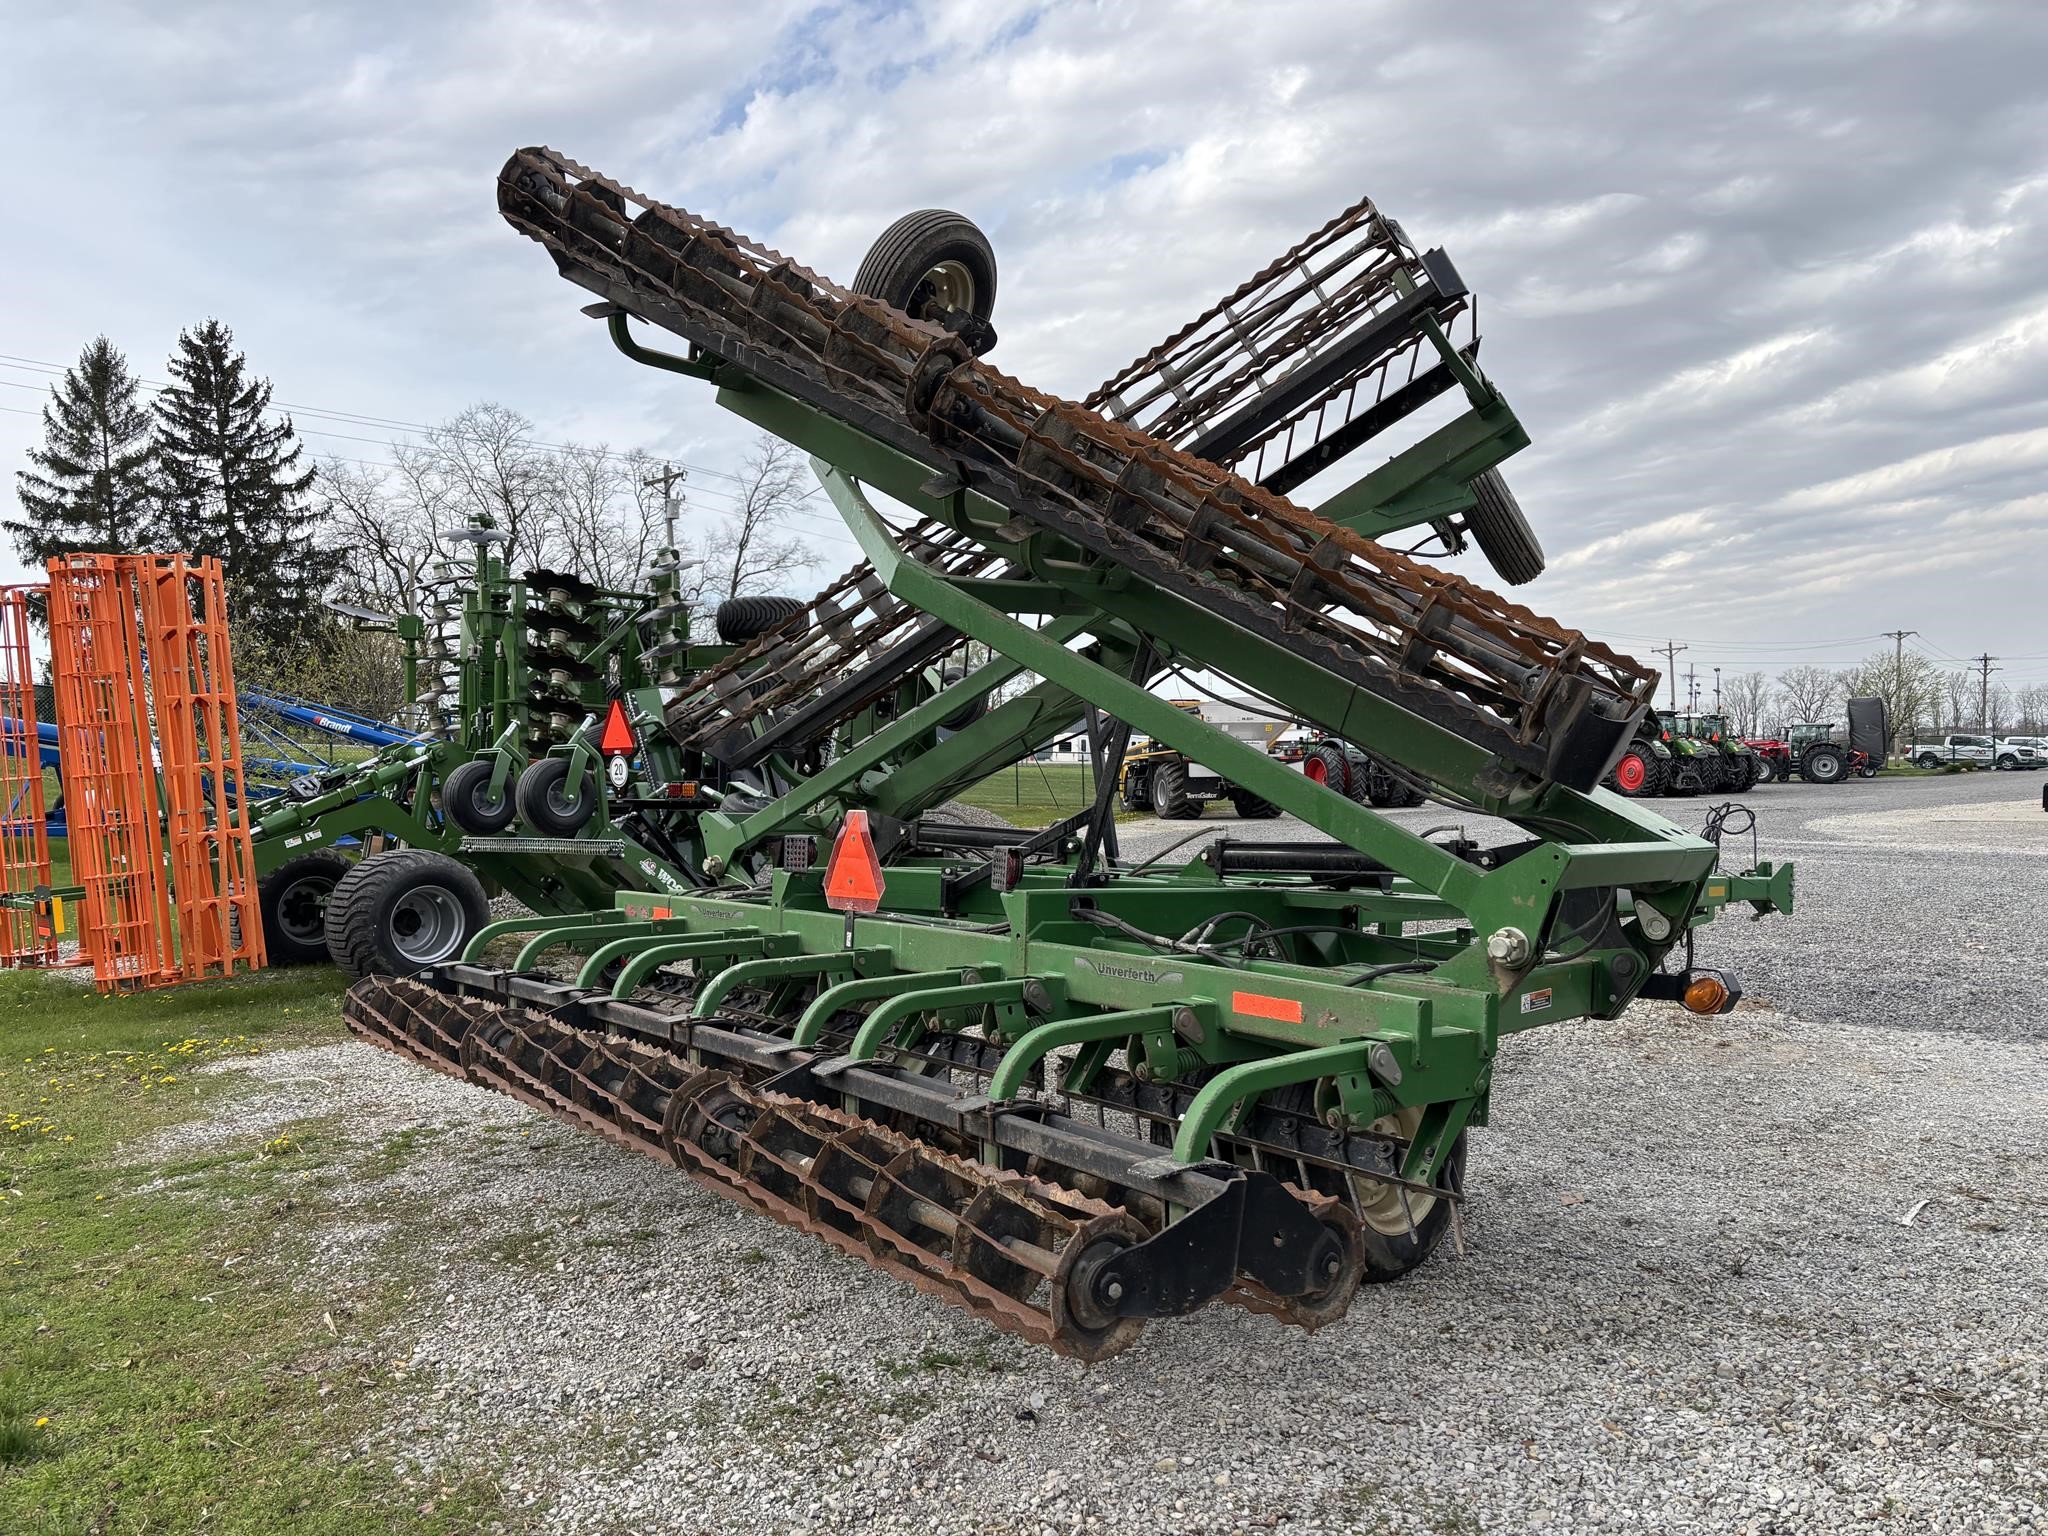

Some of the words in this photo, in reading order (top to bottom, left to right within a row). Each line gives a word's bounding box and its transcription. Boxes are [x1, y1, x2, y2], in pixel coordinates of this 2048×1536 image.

[319, 717, 352, 734] Brandt
[614, 763, 624, 775] 20
[1185, 791, 1218, 799] TerraGator
[1098, 963, 1155, 982] Unverferth
